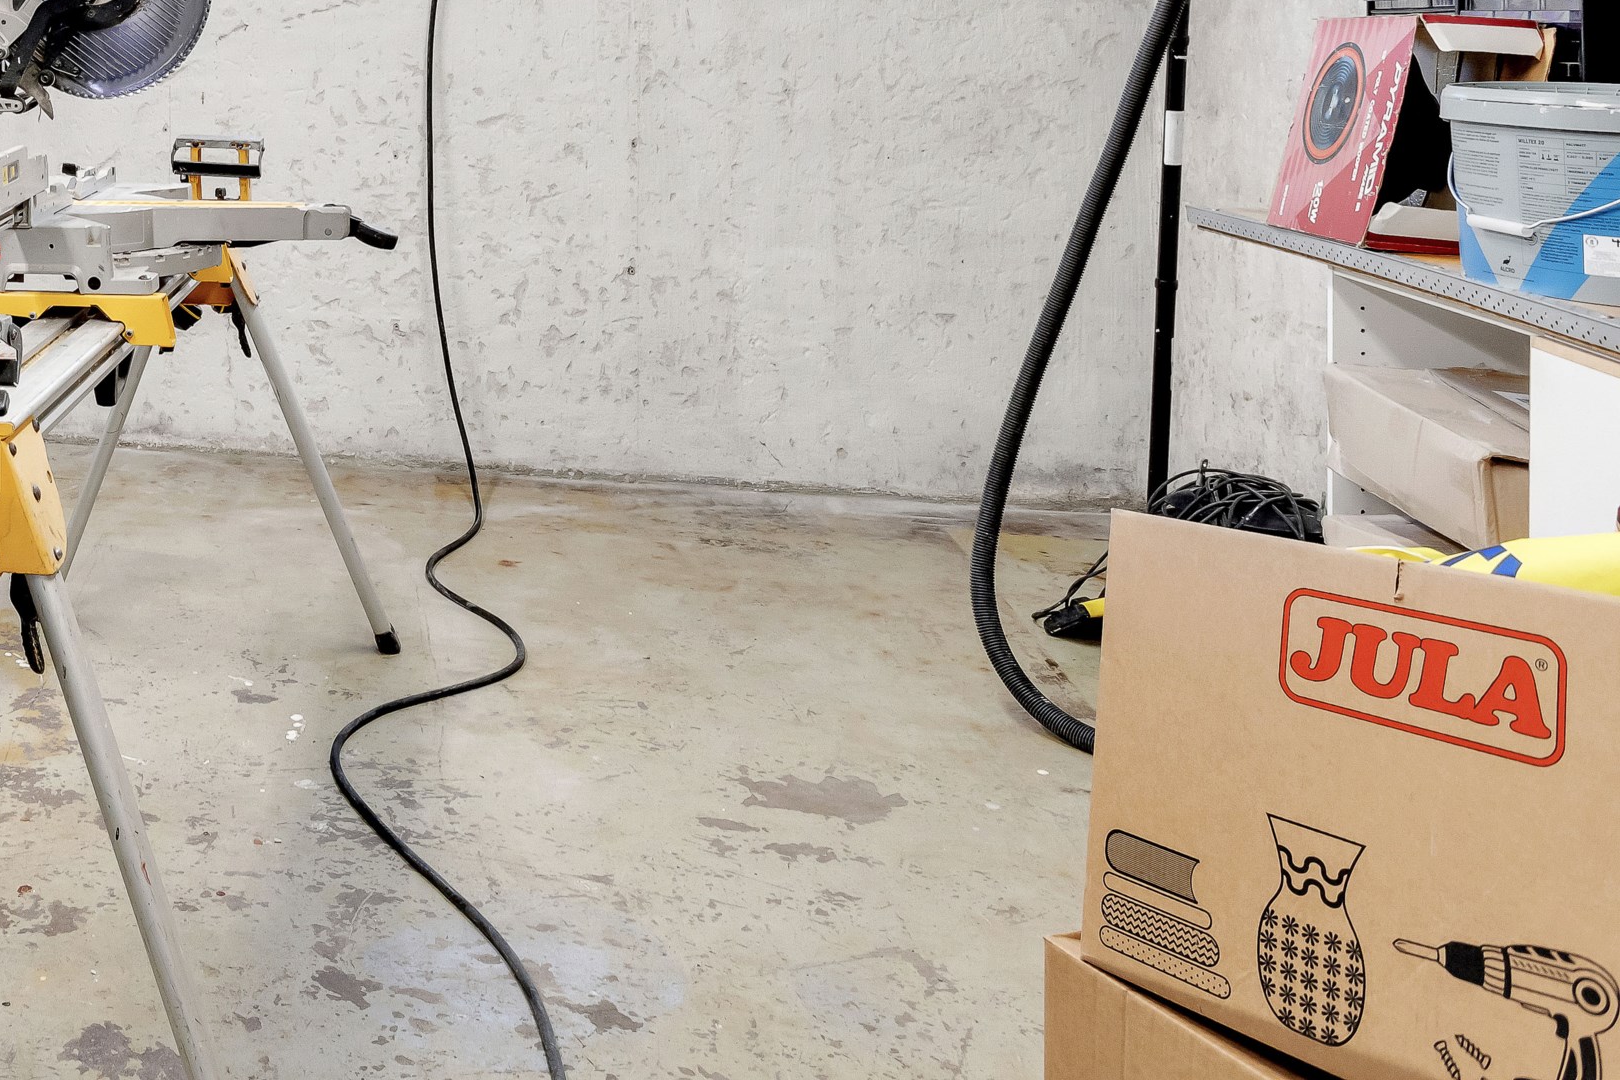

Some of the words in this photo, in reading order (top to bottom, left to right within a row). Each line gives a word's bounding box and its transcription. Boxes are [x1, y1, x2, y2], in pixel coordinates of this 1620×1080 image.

[1361, 99, 1375, 140] COATED
[1365, 61, 1402, 196] PYRAMID
[1351, 141, 1365, 182] WOOFER
[1310, 179, 1324, 224] 120W
[1290, 616, 1552, 740] JULA
